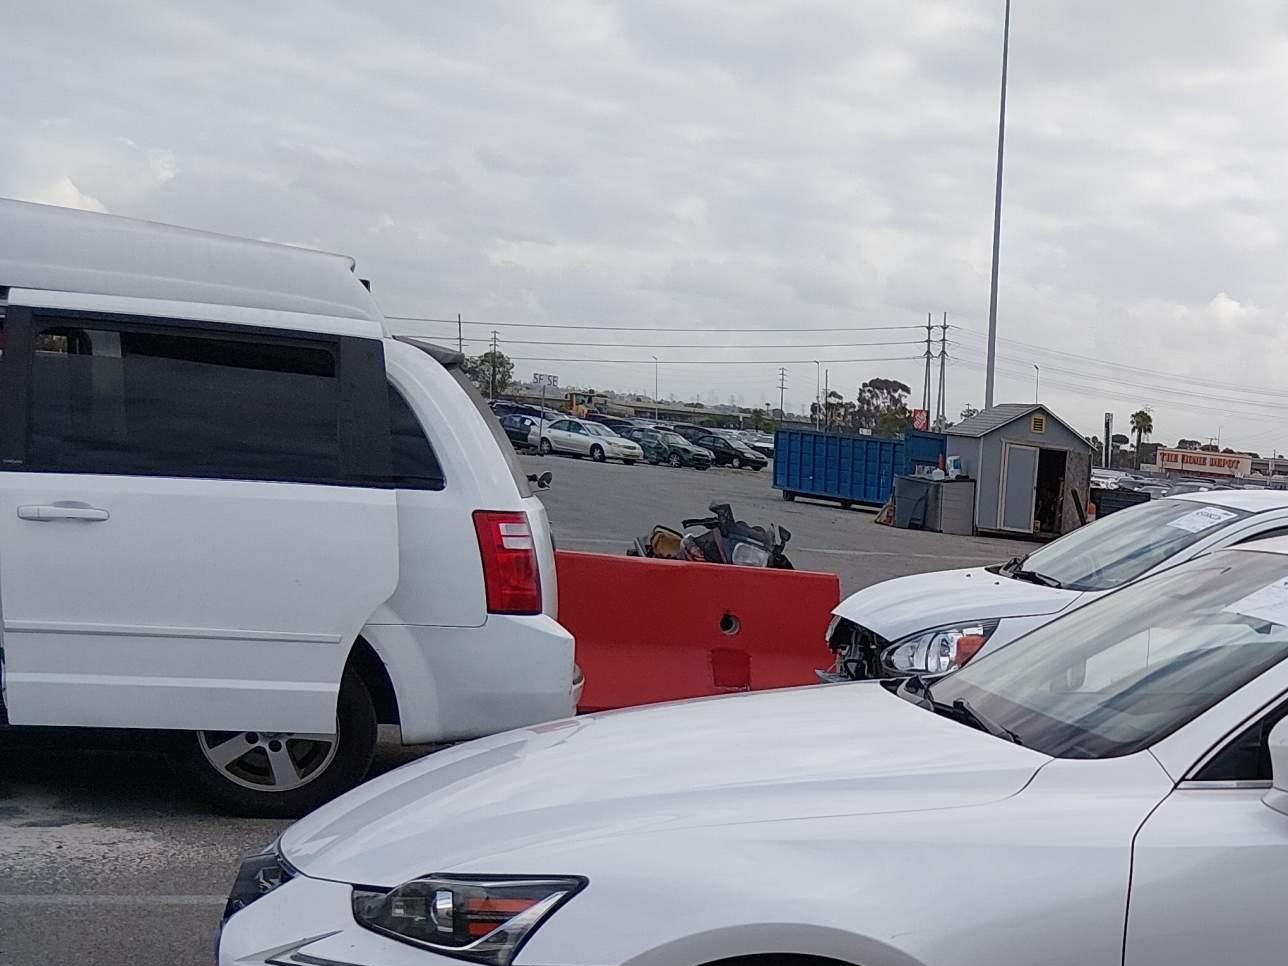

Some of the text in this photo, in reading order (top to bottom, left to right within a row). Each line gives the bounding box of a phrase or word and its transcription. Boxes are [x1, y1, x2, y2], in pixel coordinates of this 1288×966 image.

[1160, 451, 1241, 470] THE HOME DEPOT
